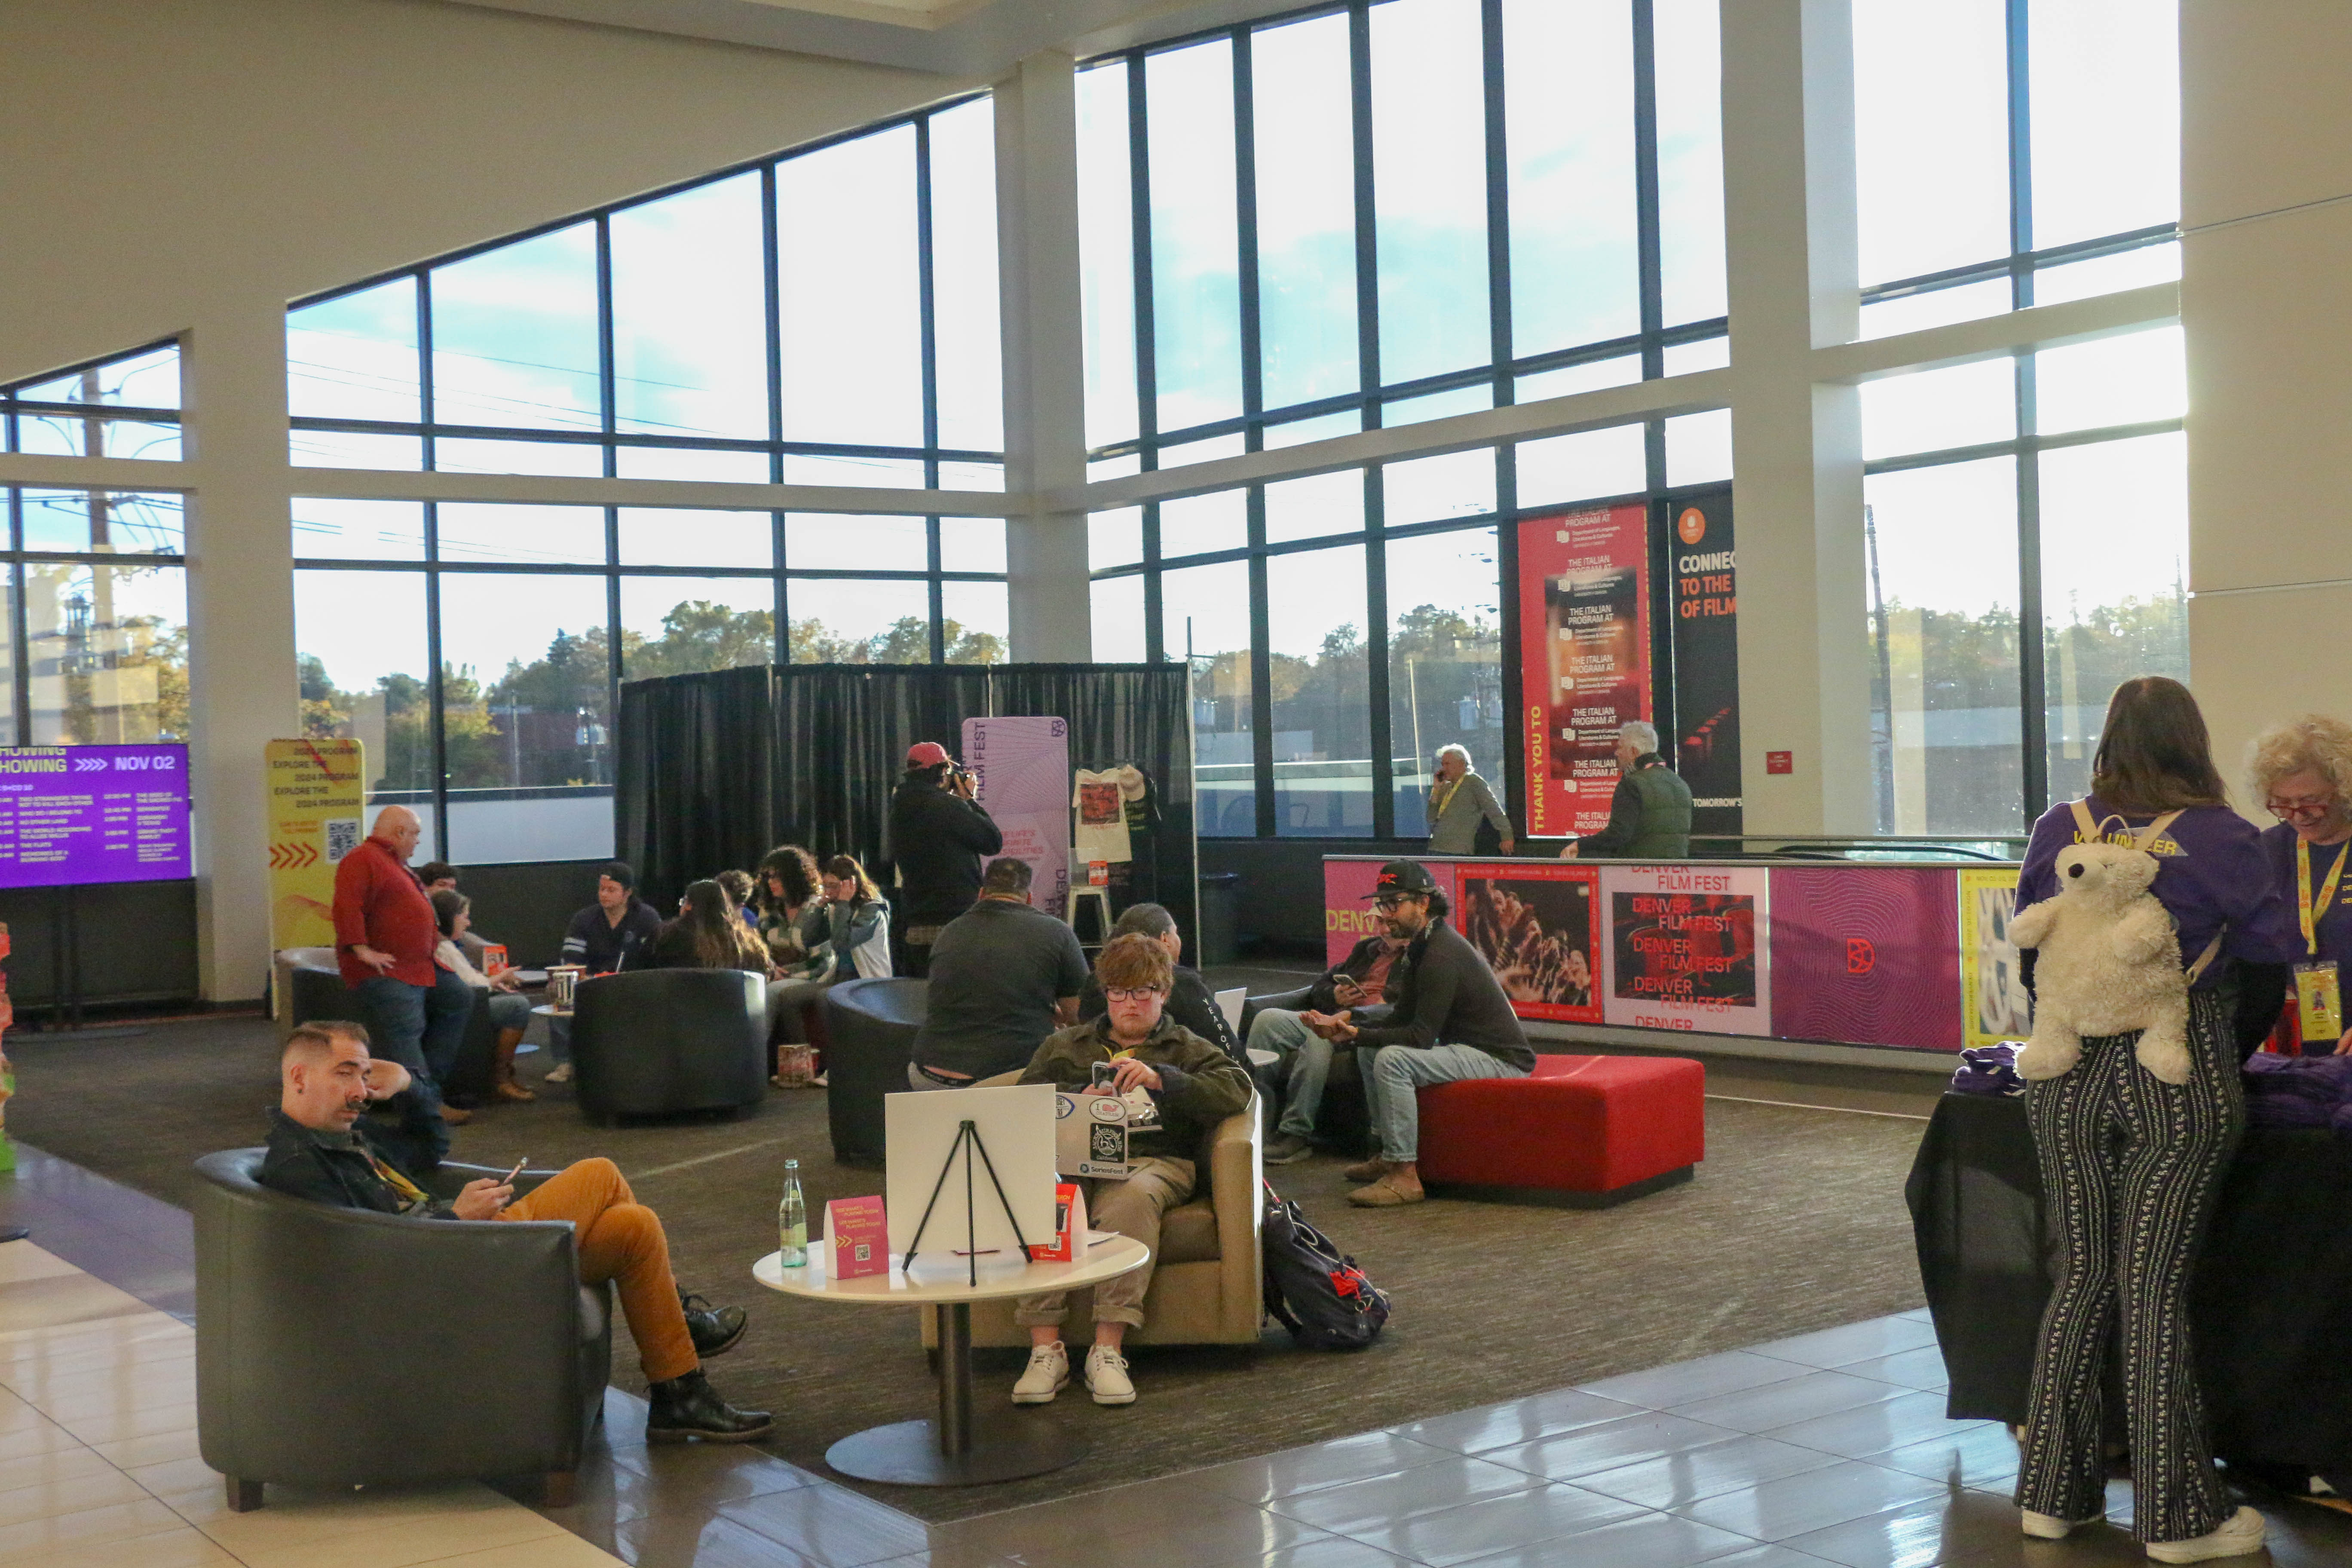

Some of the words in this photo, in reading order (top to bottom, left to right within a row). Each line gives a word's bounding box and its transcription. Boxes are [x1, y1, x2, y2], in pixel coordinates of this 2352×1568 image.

[1565, 515, 1600, 527] PROGRAM
[1568, 558, 1582, 567] THE
[1583, 555, 1610, 565] ITALIAN
[1680, 578, 1700, 596] TO
[1703, 574, 1732, 593] THE
[1569, 607, 1584, 616] THE
[1584, 604, 1612, 615] ITALIAN
[1681, 600, 1700, 618] OF
[1703, 596, 1737, 616] FILM
[1568, 614, 1603, 625] PROGRAM
[1605, 613, 1614, 622] AT
[1571, 656, 1585, 665] THE
[1586, 654, 1613, 665] ITALIAN
[1570, 664, 1605, 674] PROGRAM
[1606, 663, 1615, 671] AT
[1531, 706, 1541, 729] TO
[1572, 708, 1587, 717] THE
[1588, 707, 1615, 716] ITALIAN
[1571, 717, 1607, 726] PROGRAM
[1608, 715, 1617, 724] AT
[974, 722, 985, 760] FEST
[1532, 733, 1542, 767] YOU
[115, 756, 150, 770] NOV
[153, 756, 175, 770] 02
[1574, 760, 1589, 769] THE
[1589, 759, 1617, 768] ITALIAN
[1573, 769, 1608, 778] PROGRAM
[1609, 768, 1619, 776] AT
[974, 764, 985, 801] FILM
[1534, 772, 1544, 832] THANK
[1576, 812, 1590, 820] THE
[1658, 875, 1690, 890] FILM
[1695, 876, 1730, 891] FEST
[1632, 897, 1692, 914] DENVER
[1659, 914, 1692, 930] FILM
[1695, 916, 1732, 932] FEST
[1634, 937, 1692, 954] DENVER
[1660, 955, 1693, 970] FILM
[1697, 956, 1733, 972] FEST
[1634, 977, 1693, 994] DENVER
[1661, 994, 1694, 1010] FILM
[1698, 996, 1734, 1013] FEST
[1635, 1016, 1693, 1030] DENVER
